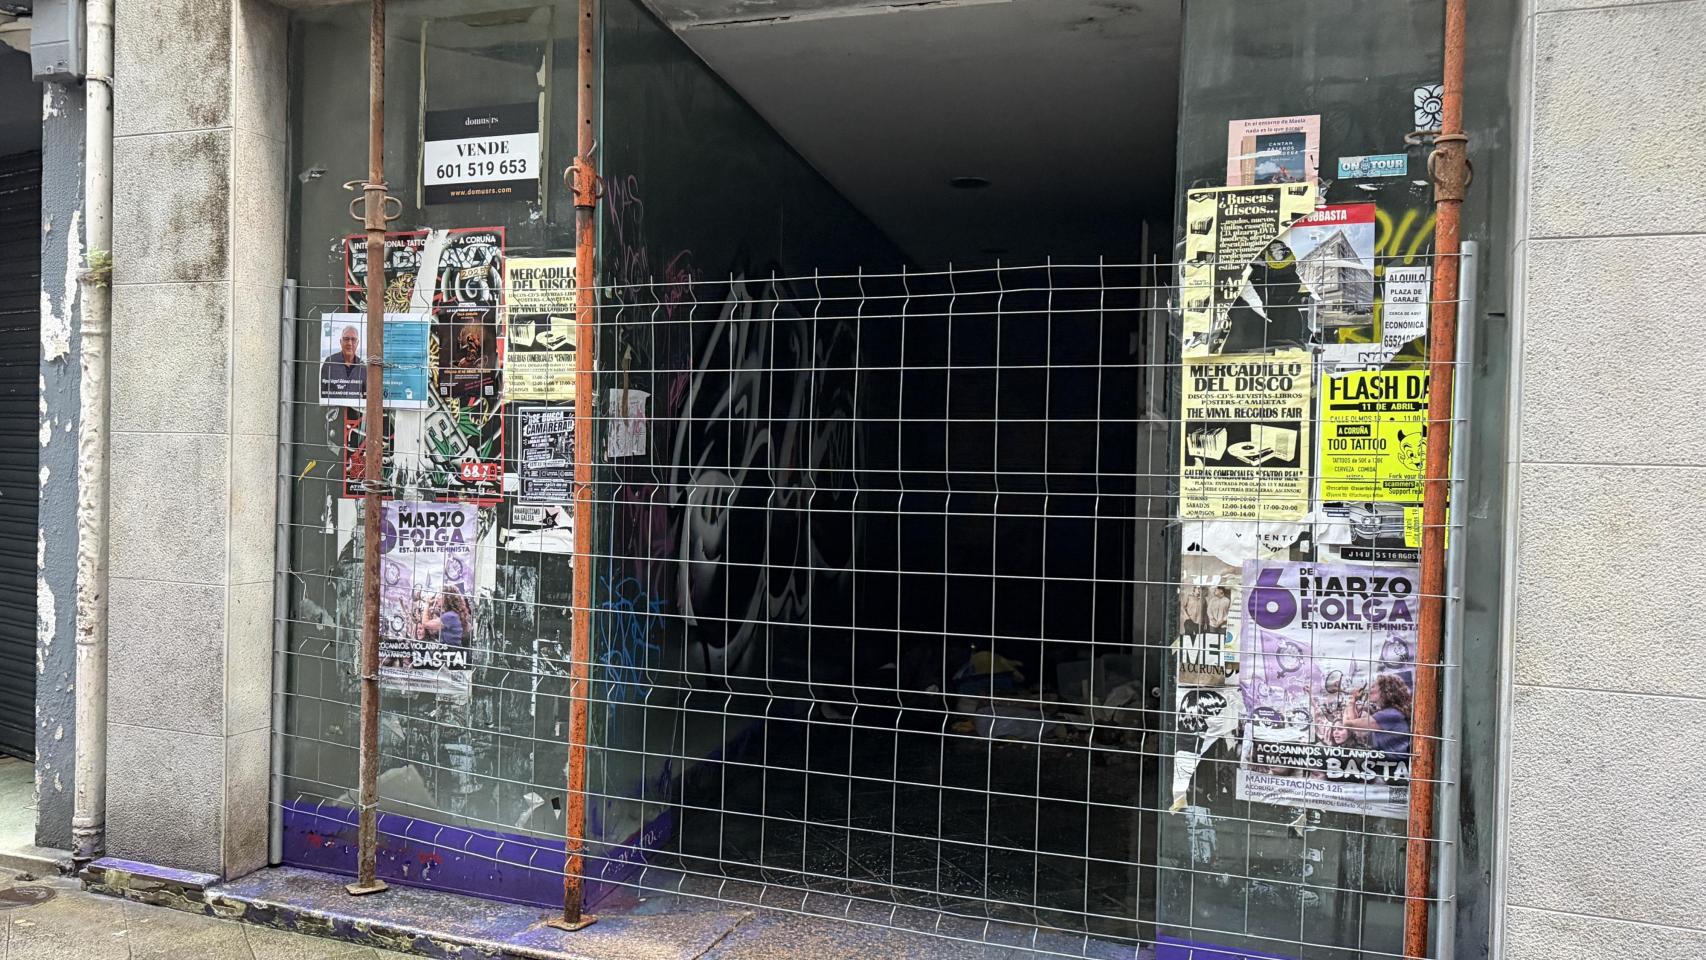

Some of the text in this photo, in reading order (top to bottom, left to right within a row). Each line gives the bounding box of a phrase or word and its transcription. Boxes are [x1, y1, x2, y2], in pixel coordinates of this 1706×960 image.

[456, 140, 510, 158] VENDE
[436, 158, 527, 179] 601 519 653
[1342, 159, 1404, 172] ON TOUR
[450, 186, 512, 197] www.domusrs.com
[1219, 193, 1274, 208] ¿Buscas
[1224, 205, 1278, 216] discos...
[466, 233, 496, 244] CORUÑA
[510, 267, 577, 281] MERCADILL
[1388, 273, 1425, 284] ALQUILO
[512, 279, 577, 291] DEL DISCO
[1384, 320, 1425, 329] ECONÓMICA
[1190, 362, 1301, 377] MERCADILLO
[1194, 377, 1293, 392] DEL DISCO
[1330, 375, 1430, 400] FLASH DA
[1186, 407, 1303, 418] THE VINYL RECORDS FAIR
[1390, 402, 1415, 410] ABRIL
[1338, 426, 1369, 435] A CORUÑA
[1328, 438, 1387, 451] TOO TATTOO
[398, 511, 465, 528] MARZO
[399, 528, 465, 546] FOLGA
[1300, 568, 1313, 576] DE
[1248, 568, 1412, 630] 6 MARZO
[1301, 598, 1413, 623] FOLGA
[1301, 621, 1363, 631] ESTUDANTIL
[412, 650, 468, 669] BASTA!
[1179, 661, 1225, 675] A CORUÑA
[1257, 754, 1263, 763] E
[1245, 774, 1343, 793] MANIFESTACIÓNS 12h
